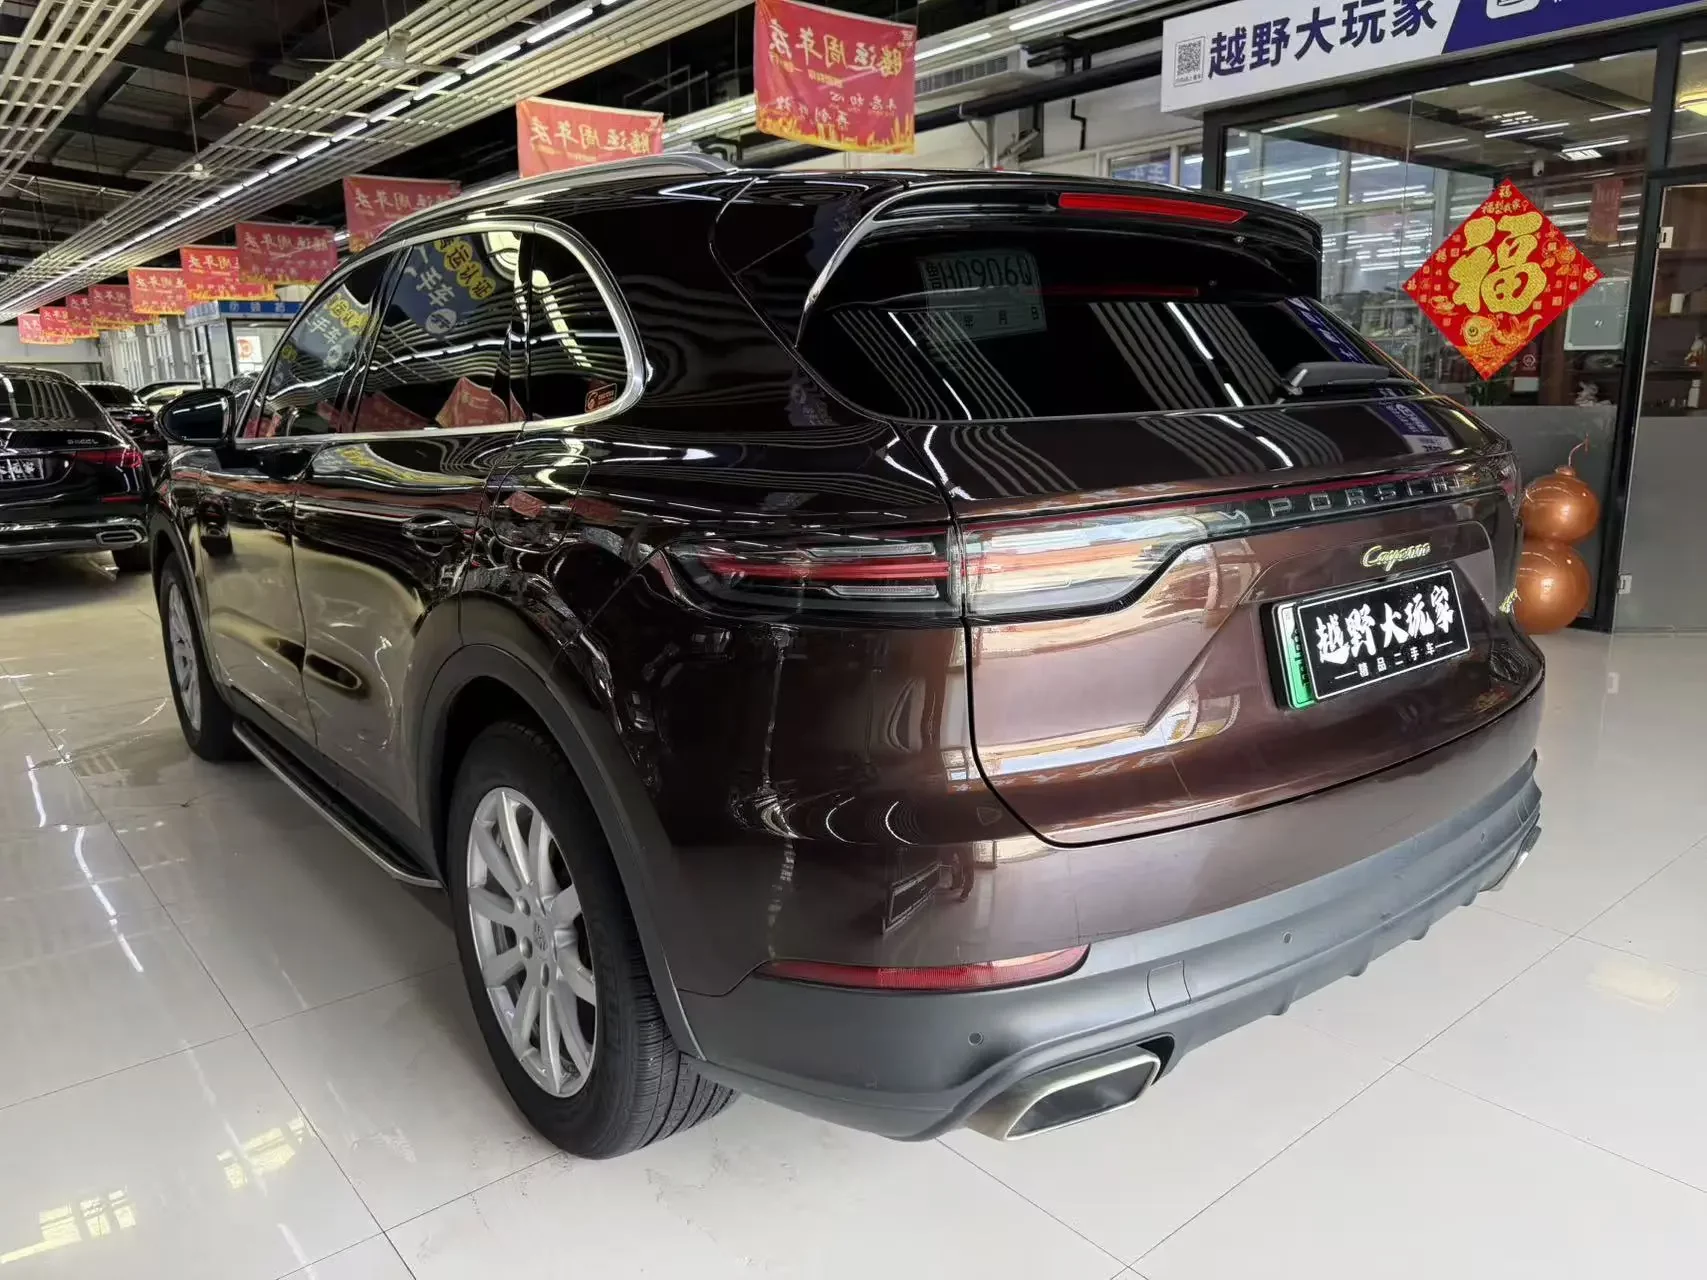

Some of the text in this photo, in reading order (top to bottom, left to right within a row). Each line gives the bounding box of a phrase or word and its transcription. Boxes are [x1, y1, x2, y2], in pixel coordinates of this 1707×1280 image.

[1207, 0, 1437, 79] 越野大玩家
[1448, 211, 1544, 315] 福
[1315, 584, 1455, 665] 越野大玩家
[1357, 641, 1437, 679] 精品二手车
